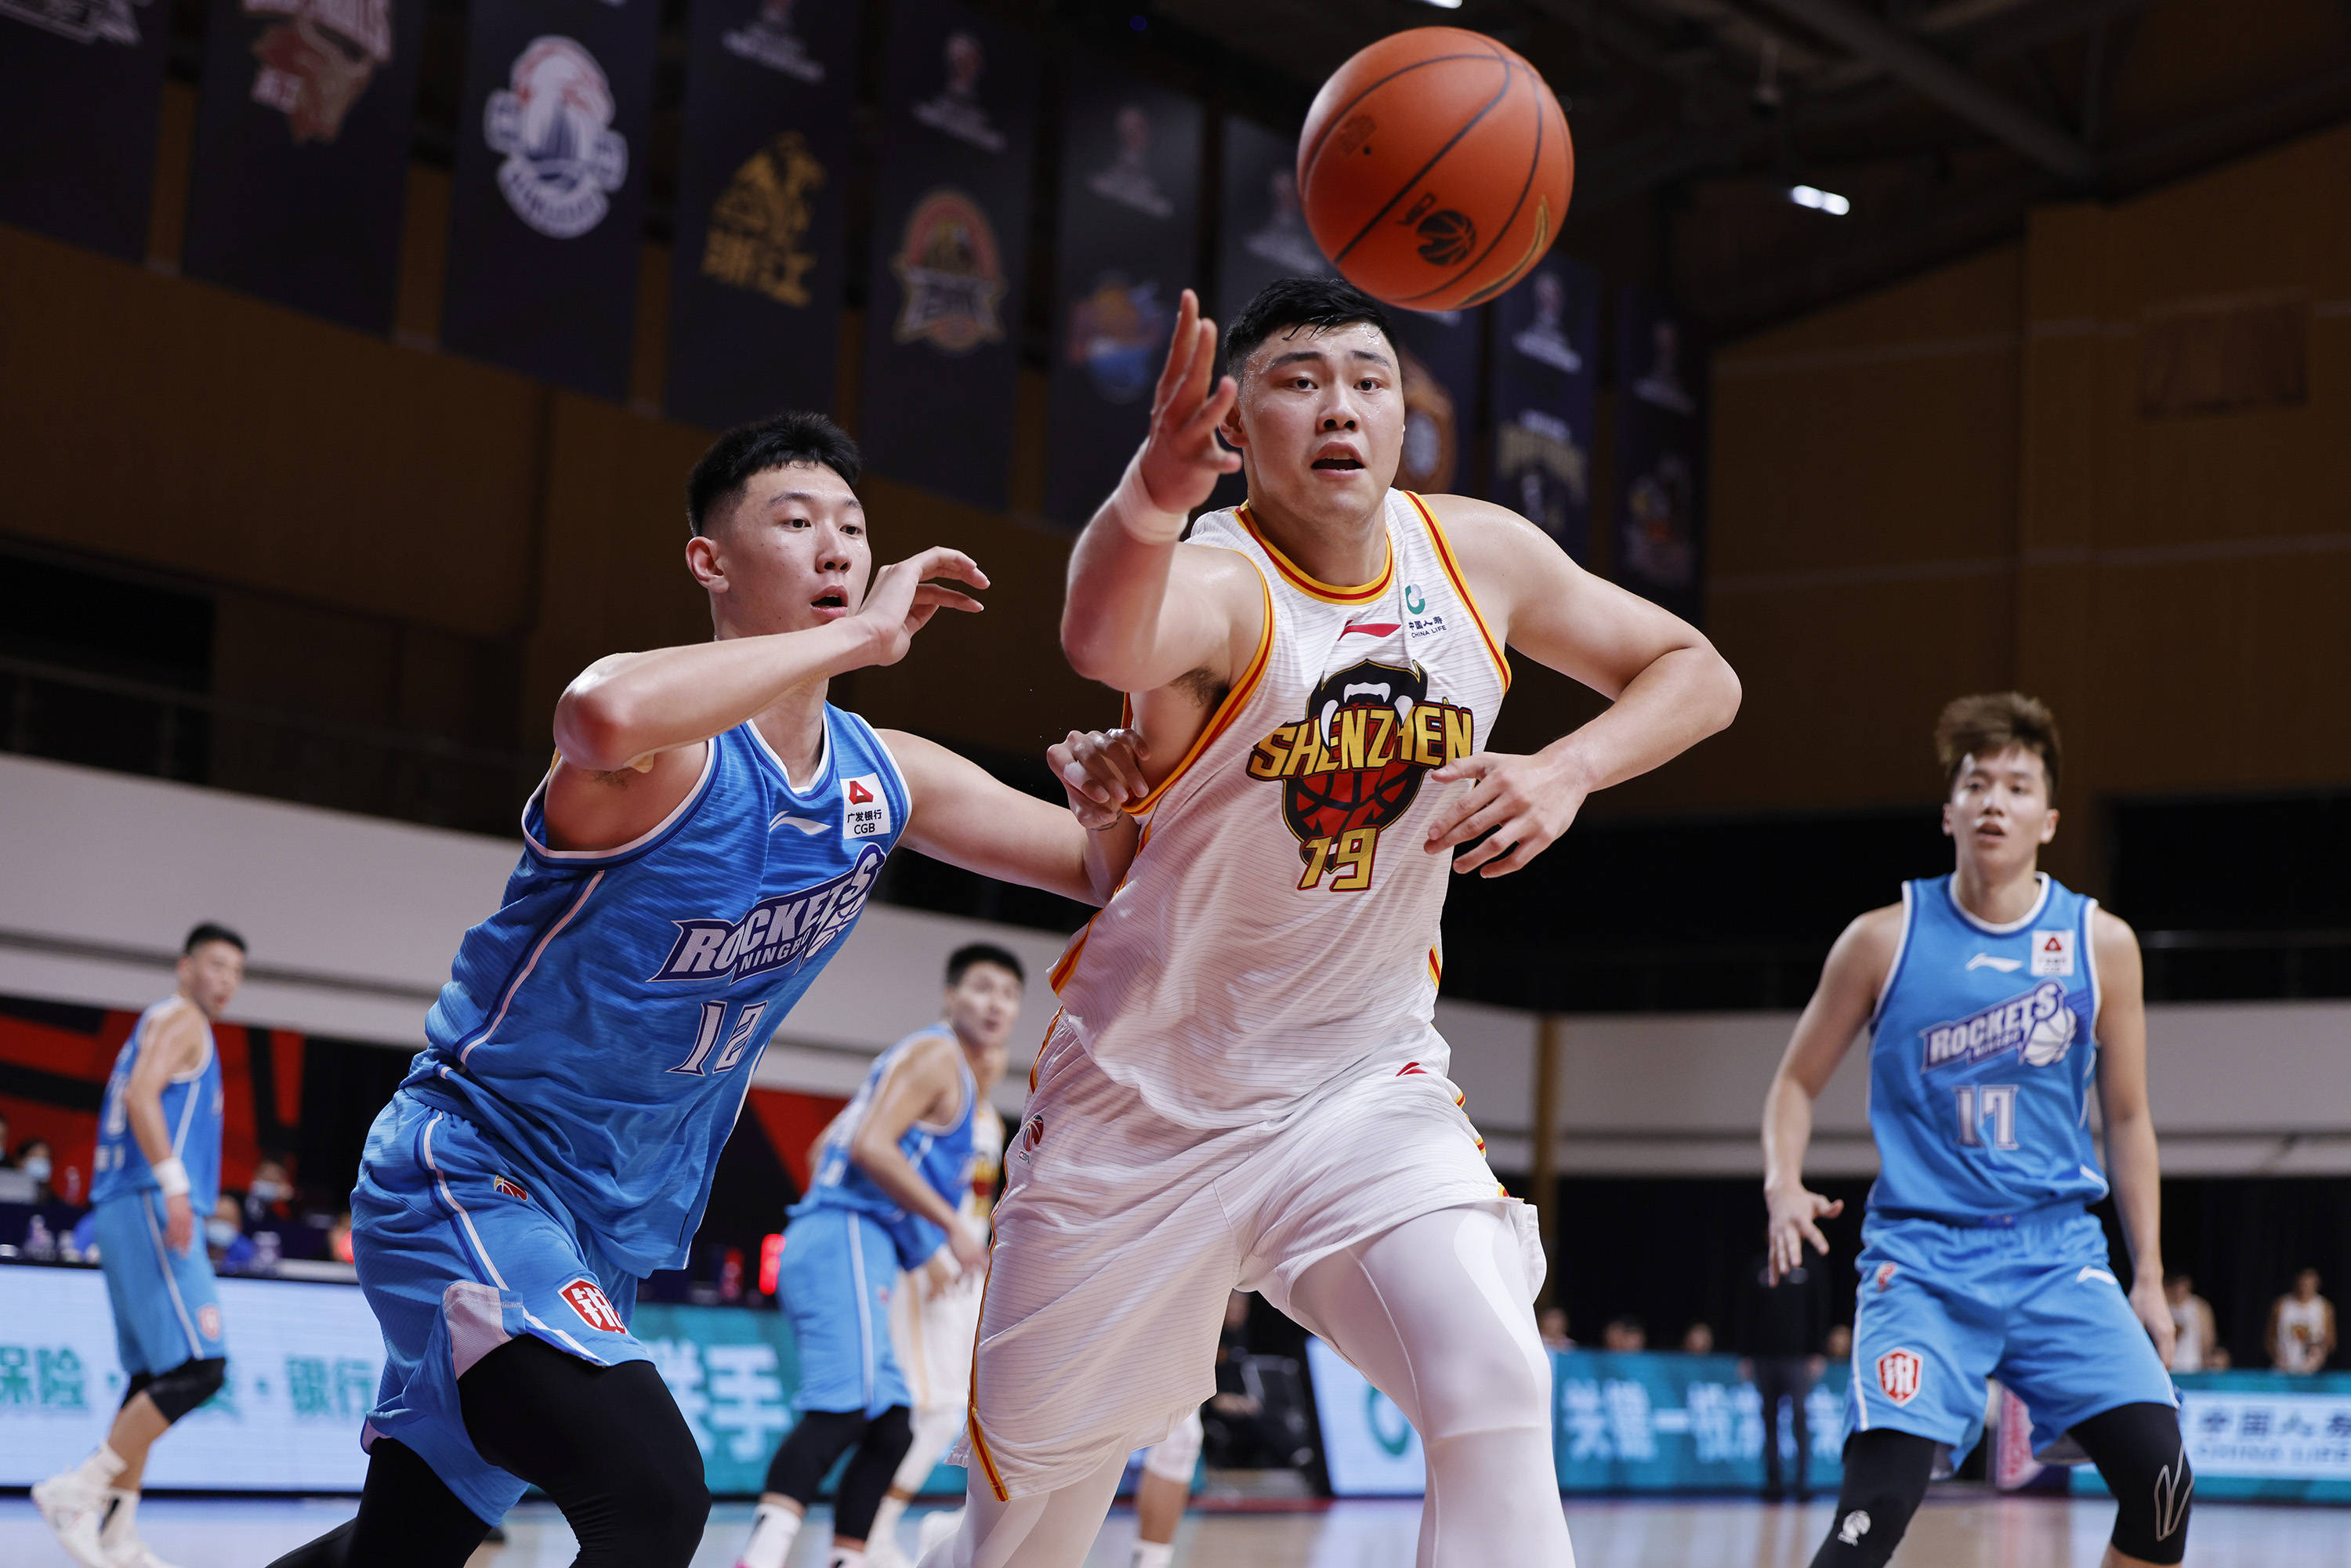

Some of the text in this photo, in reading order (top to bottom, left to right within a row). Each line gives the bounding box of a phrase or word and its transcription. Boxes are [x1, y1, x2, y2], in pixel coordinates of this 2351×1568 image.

[1408, 616, 1443, 631] 中国人寿
[1411, 625, 1447, 639] CHINA LIFE
[1248, 704, 1473, 779] SHENZHEN
[847, 809, 882, 824] 广发银行
[854, 823, 875, 835] CGB
[1297, 826, 1380, 892] 19
[669, 850, 881, 973] ROCKETS
[739, 928, 812, 973] NINGBO
[666, 1000, 769, 1076] 12
[1929, 982, 2059, 1063] ROCKETS
[1953, 1084, 2020, 1151] 17
